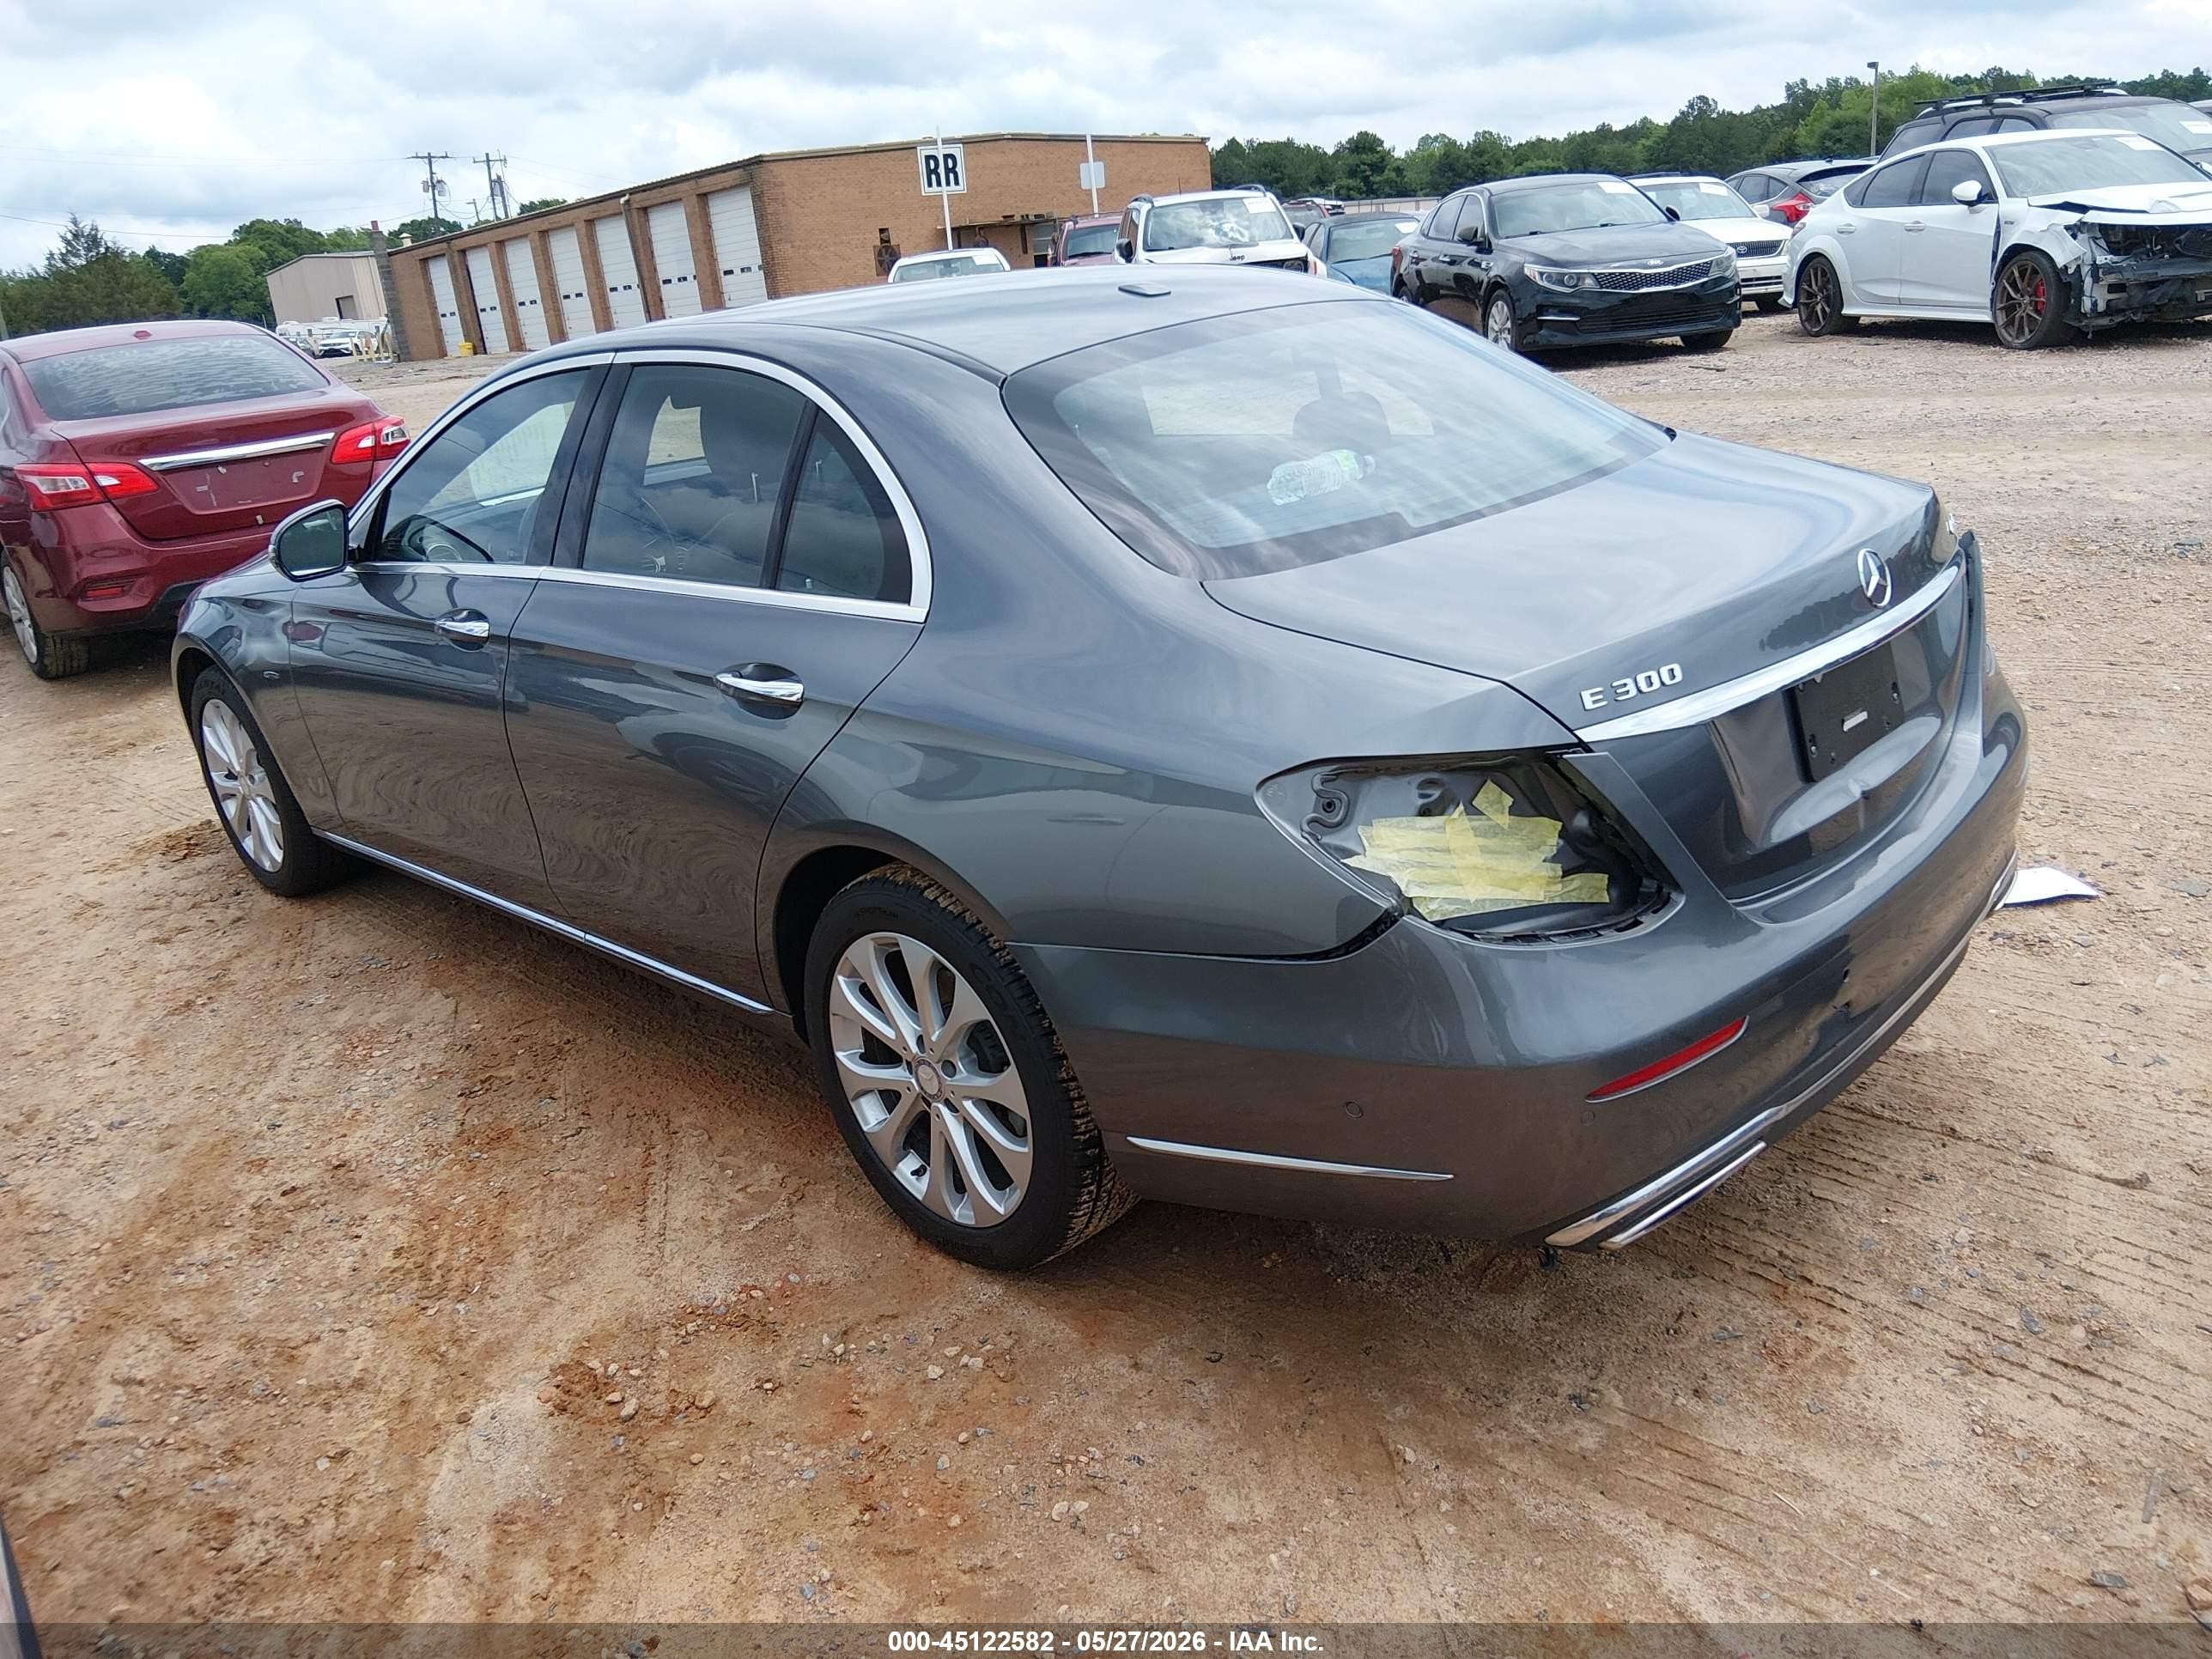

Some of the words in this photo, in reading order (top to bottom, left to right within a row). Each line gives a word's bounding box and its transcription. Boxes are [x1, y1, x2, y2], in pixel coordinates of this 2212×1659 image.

[924, 153, 960, 188] RR
[1580, 687, 1608, 711] E
[1611, 663, 1683, 702] 300
